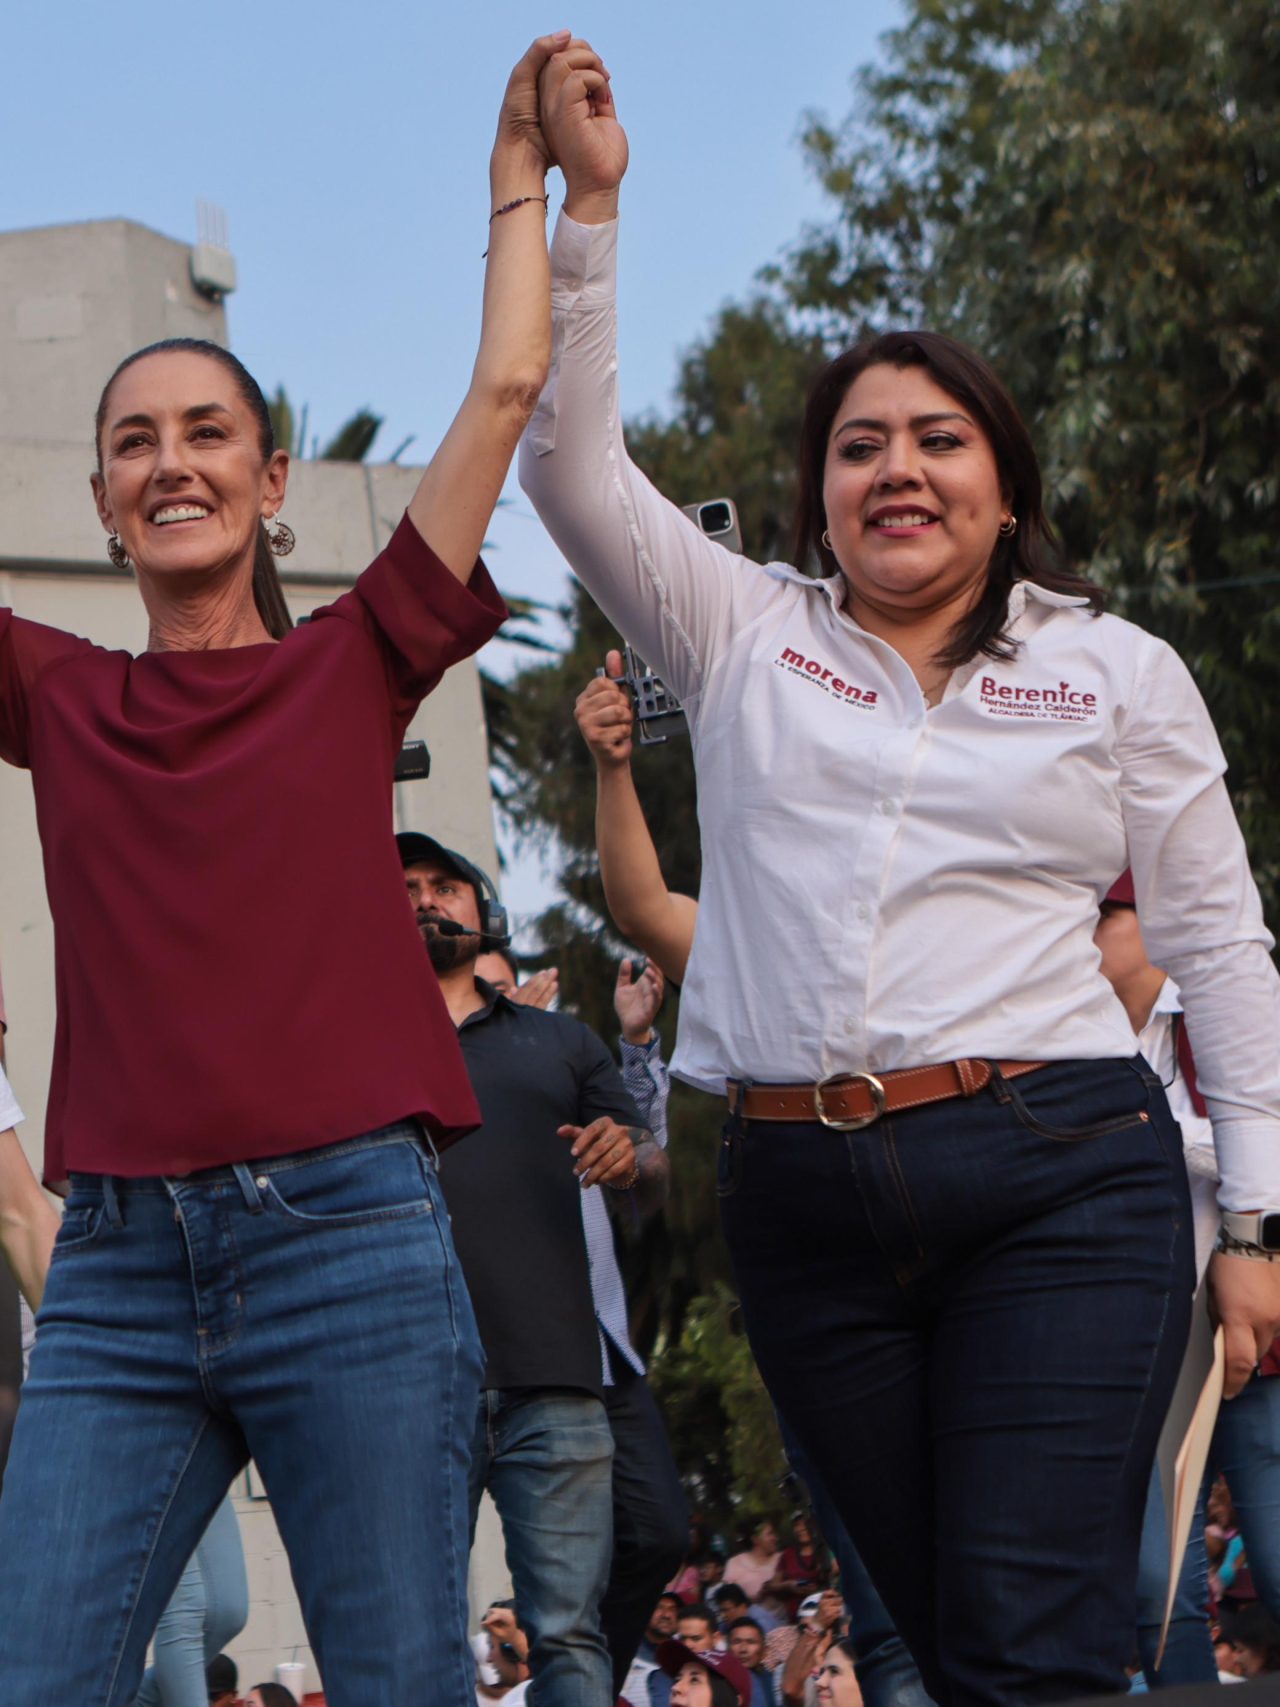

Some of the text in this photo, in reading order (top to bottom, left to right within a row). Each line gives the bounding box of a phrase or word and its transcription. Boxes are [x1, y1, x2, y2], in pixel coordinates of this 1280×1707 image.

[781, 647, 878, 704] morena
[980, 676, 1097, 707] Berenice
[980, 695, 1097, 716] Hernández Calderón
